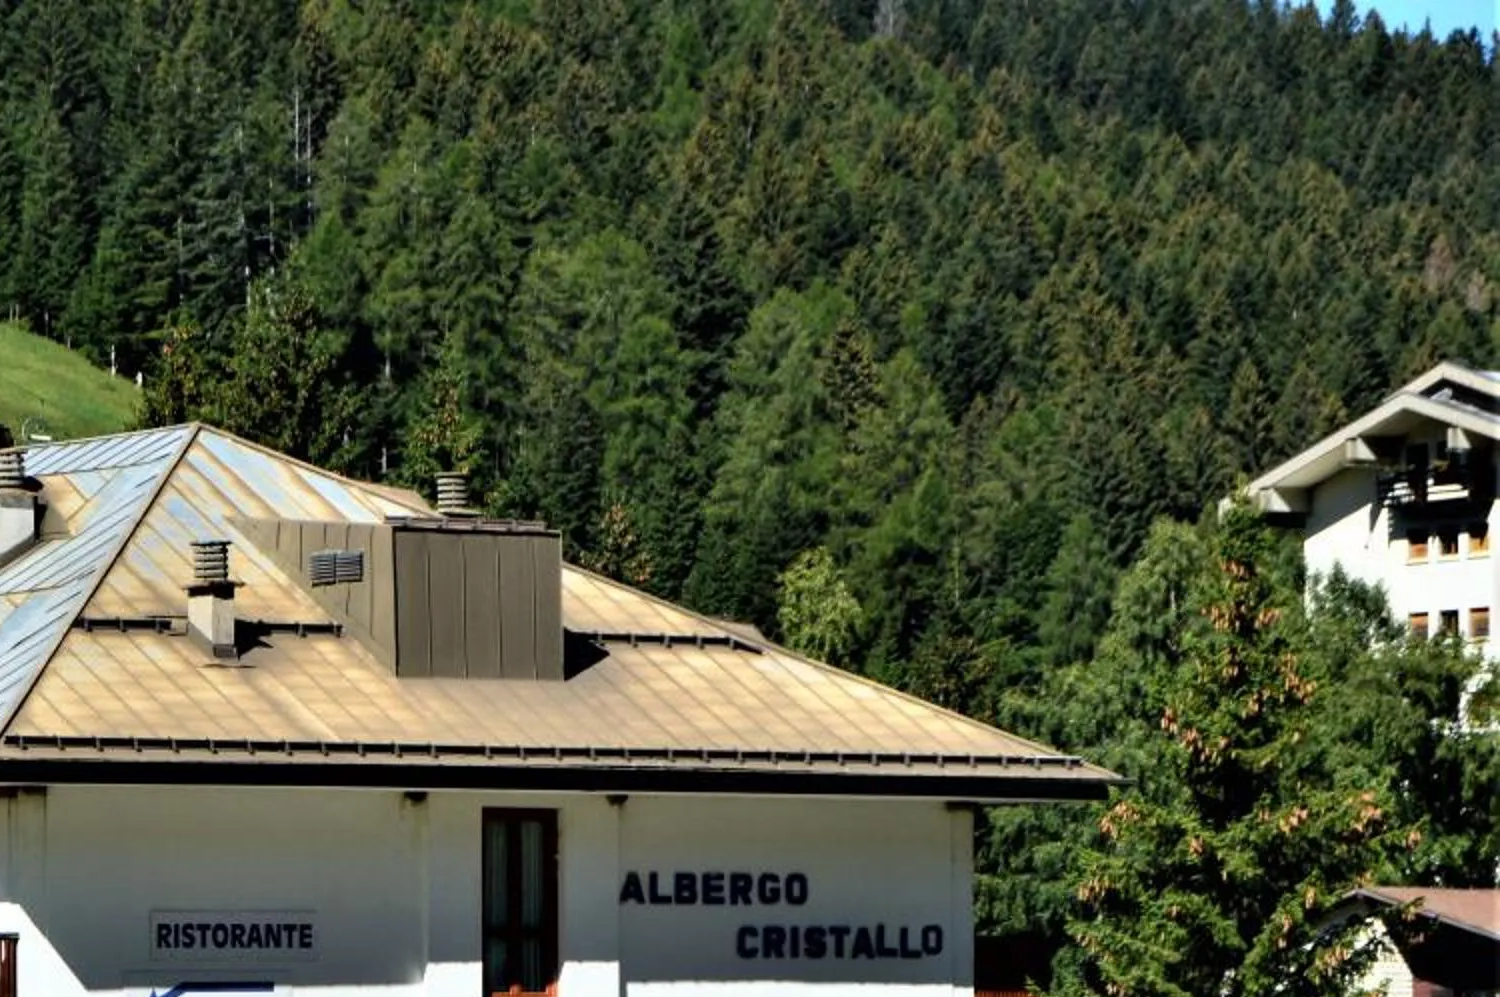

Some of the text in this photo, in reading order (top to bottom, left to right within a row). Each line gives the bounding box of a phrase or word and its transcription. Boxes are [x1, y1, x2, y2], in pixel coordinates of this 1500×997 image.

[618, 871, 809, 905] ALBERGO
[156, 923, 313, 949] RISTORANTE
[736, 923, 943, 960] CRISTALLO
